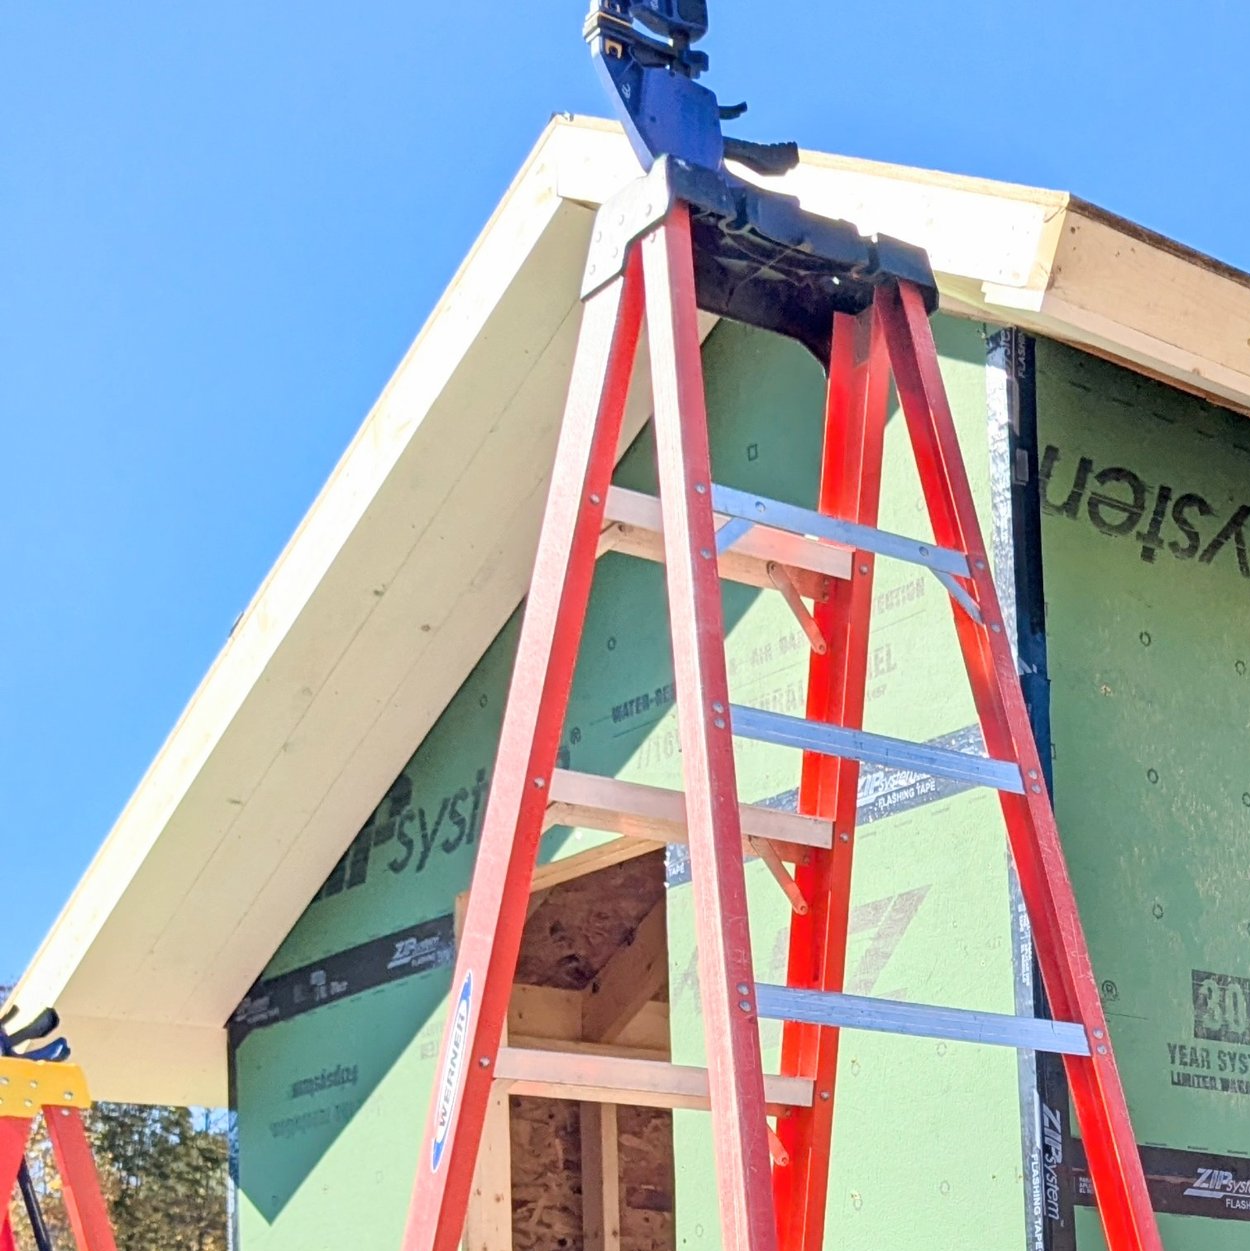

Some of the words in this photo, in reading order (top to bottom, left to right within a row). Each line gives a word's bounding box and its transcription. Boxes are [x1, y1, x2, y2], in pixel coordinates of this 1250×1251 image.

[878, 788, 914, 808] FLASHING
[916, 781, 936, 796] TAPE
[438, 1012, 470, 1128] WERNER
[1168, 1042, 1210, 1069] YEAR
[1030, 1153, 1041, 1220] FLASHING
[1035, 1221, 1044, 1251] TAPE
